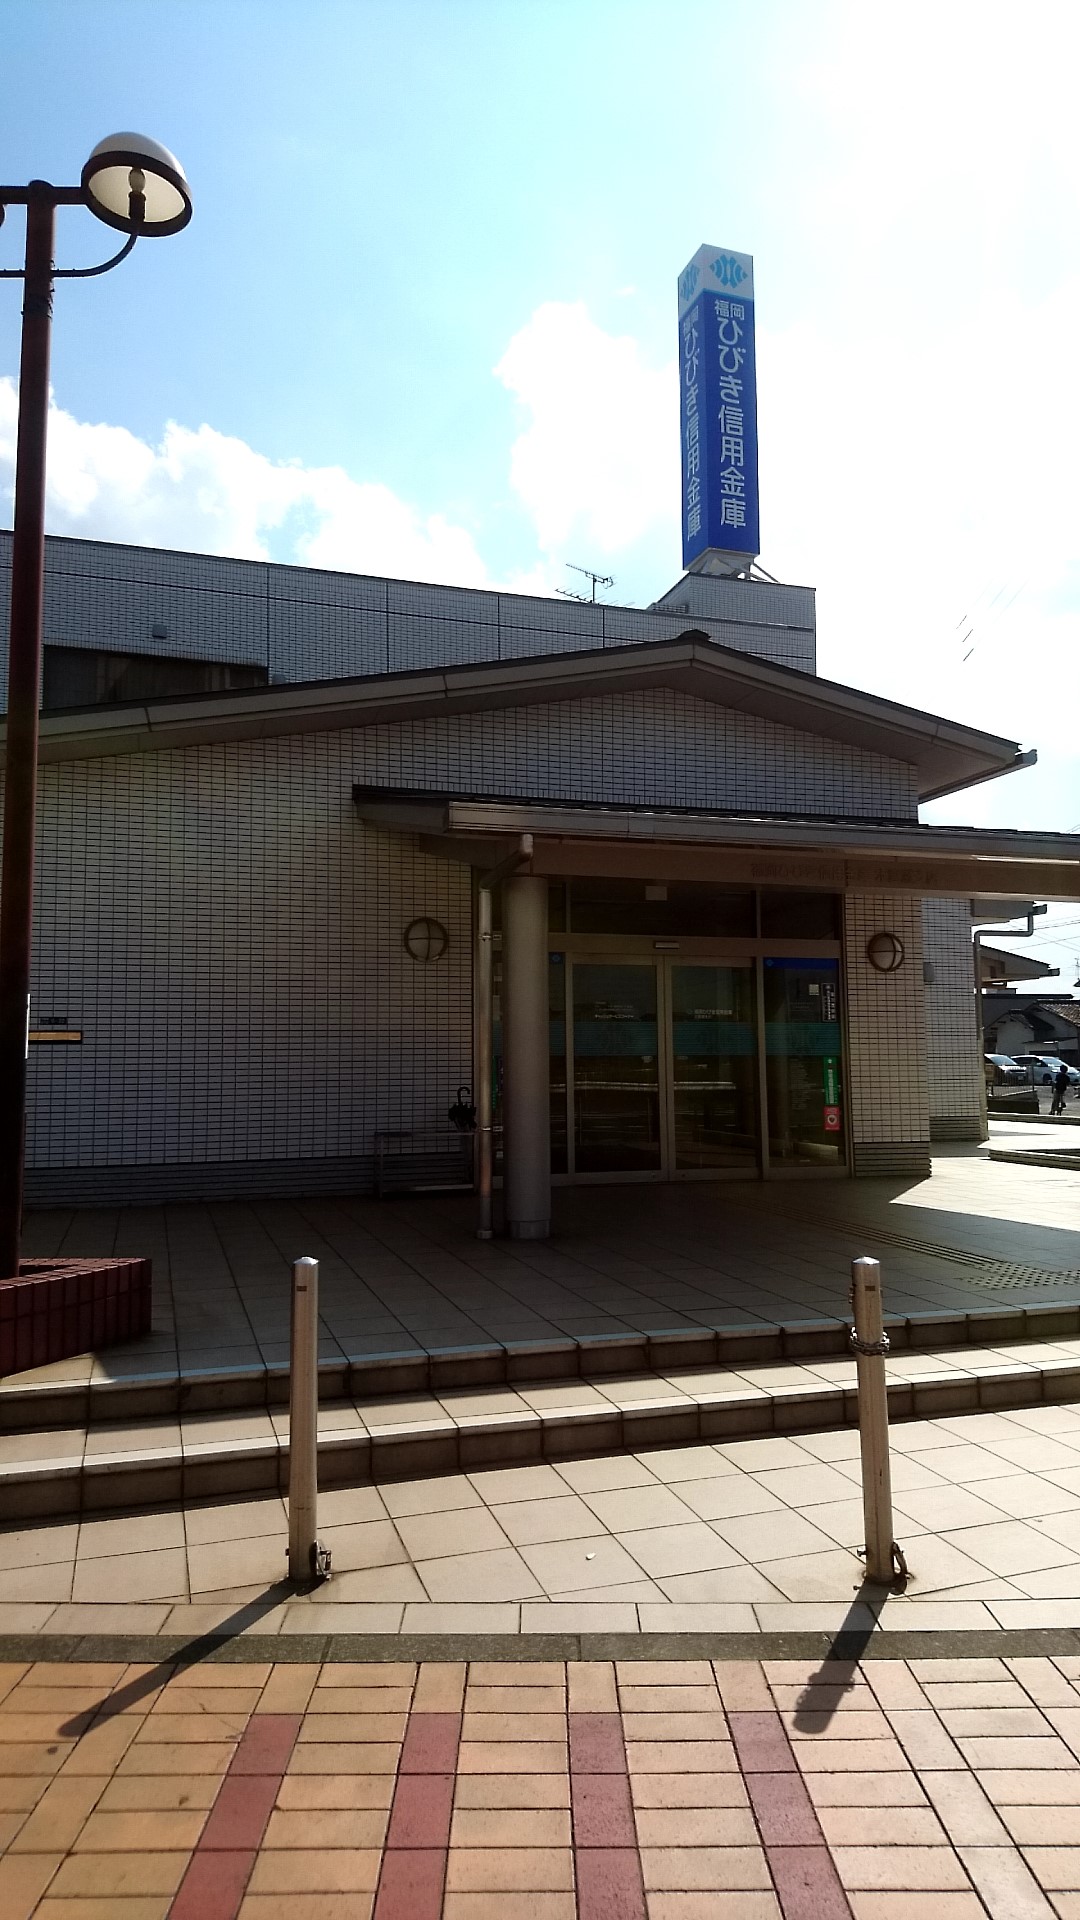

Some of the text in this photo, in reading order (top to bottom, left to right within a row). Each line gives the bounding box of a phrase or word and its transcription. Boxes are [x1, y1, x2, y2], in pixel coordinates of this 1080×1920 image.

[714, 299, 745, 321] 福岡
[684, 327, 702, 542] ひびき信用金庫
[717, 317, 747, 529] ひびき信用金庫
